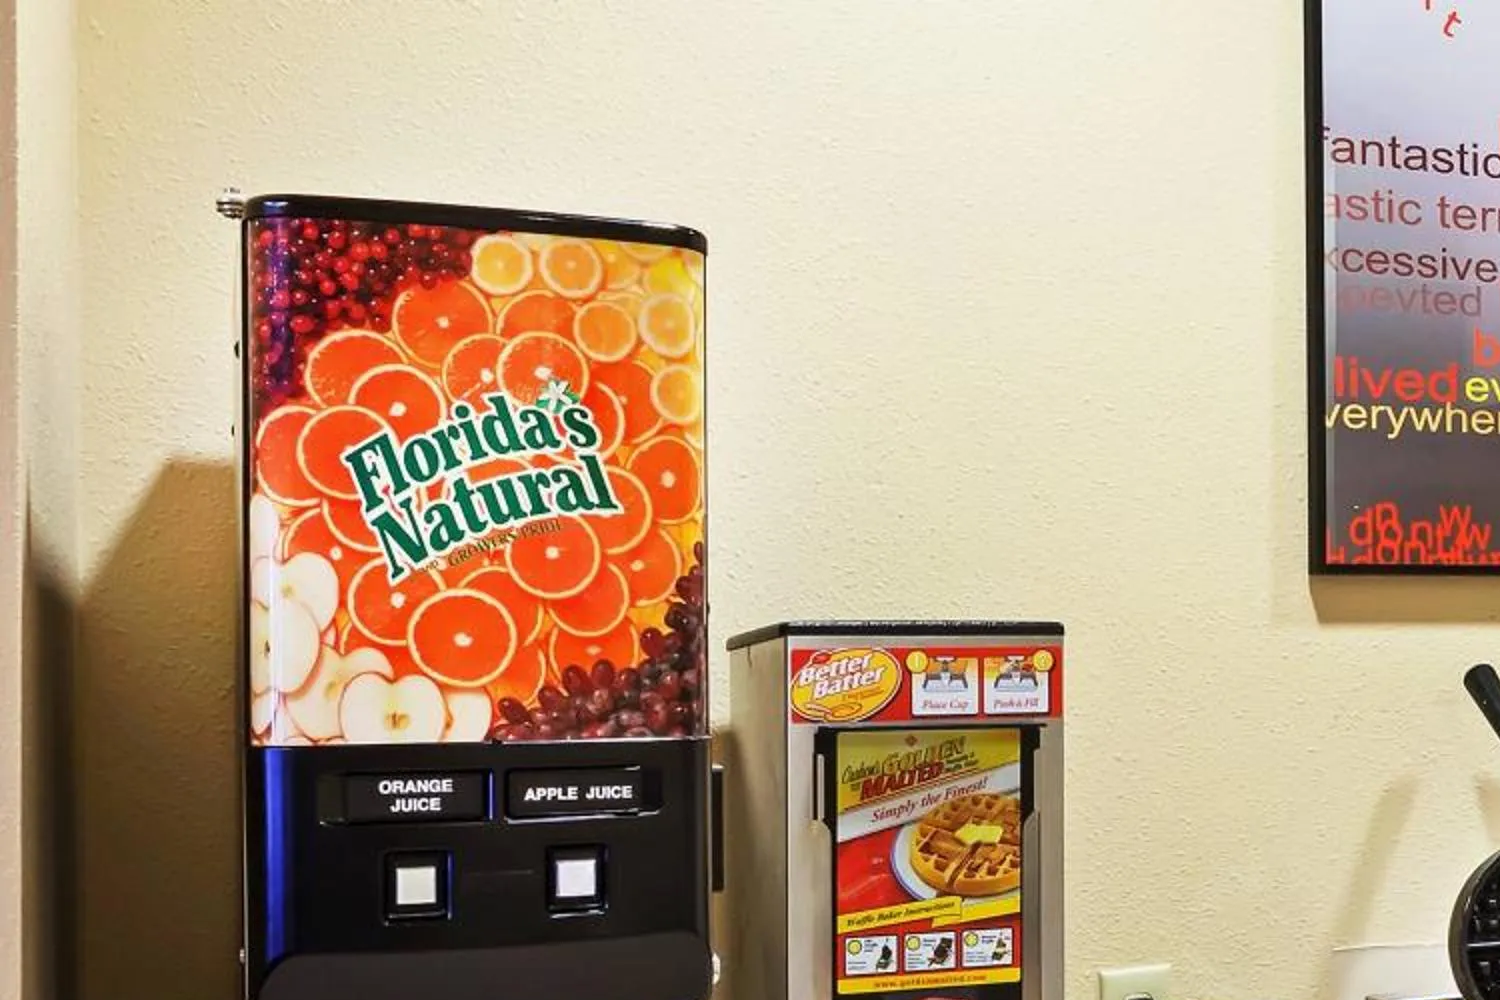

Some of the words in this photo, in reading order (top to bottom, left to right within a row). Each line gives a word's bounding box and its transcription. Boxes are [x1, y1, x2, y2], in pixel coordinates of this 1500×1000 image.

[1333, 355, 1459, 402] lived
[344, 396, 599, 511] Florida's
[371, 454, 620, 581] Natural
[799, 652, 873, 687] Better
[379, 778, 454, 795] ORANGE
[390, 796, 442, 813] JUICE
[524, 786, 579, 802] APPLE
[585, 784, 633, 800] JUICE
[871, 799, 918, 823] Simply
[920, 792, 943, 808] the
[943, 776, 989, 800] Finest!
